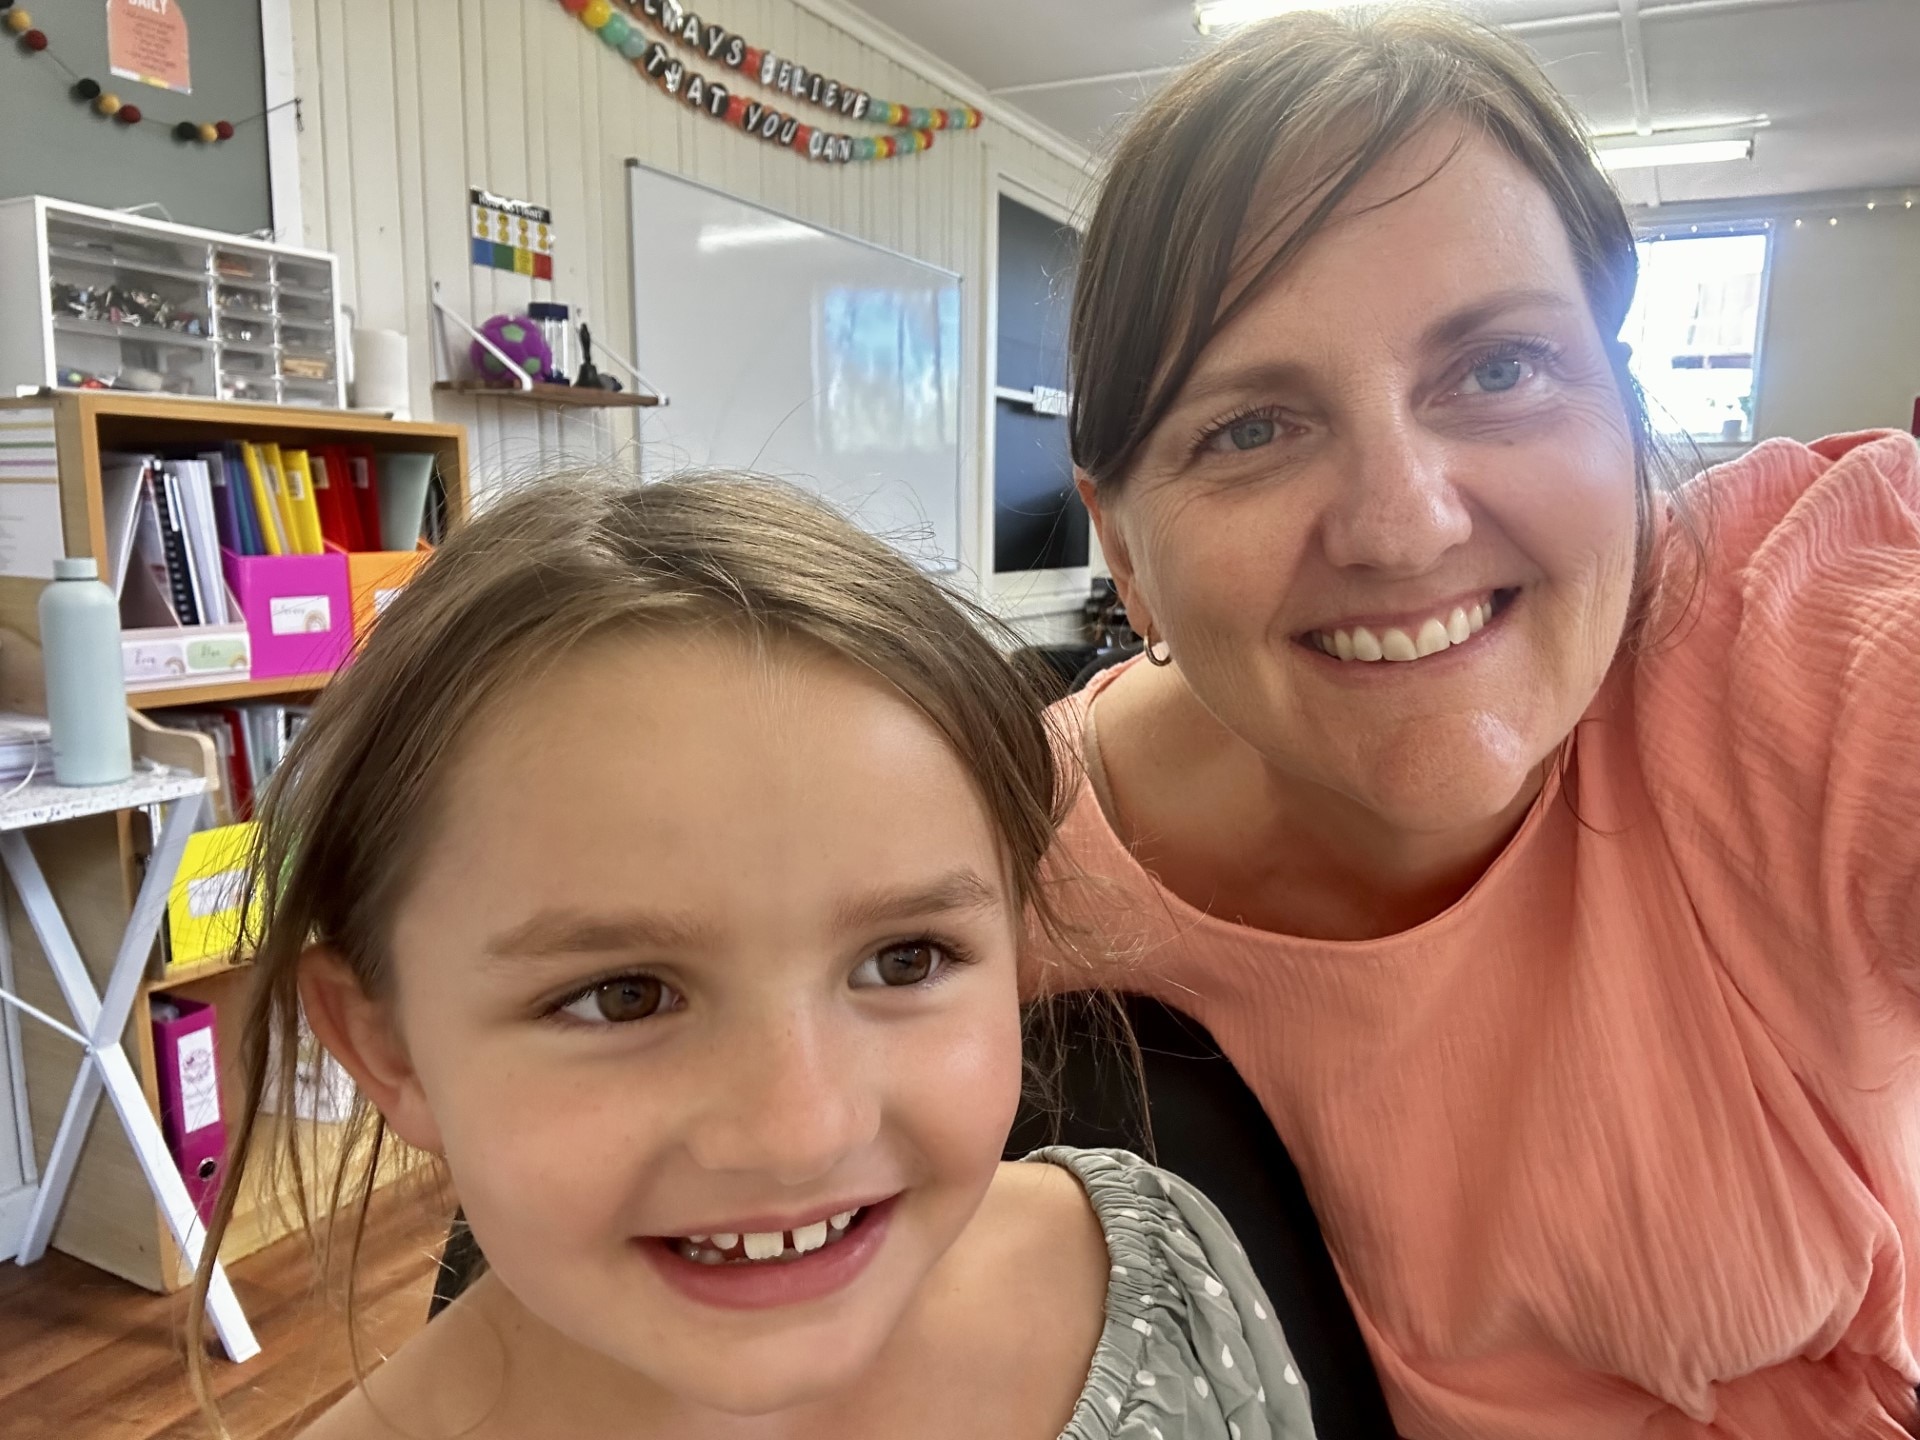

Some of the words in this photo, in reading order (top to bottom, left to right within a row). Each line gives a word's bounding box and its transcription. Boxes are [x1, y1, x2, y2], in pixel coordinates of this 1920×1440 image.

[629, 0, 743, 66] LWAYS
[761, 54, 869, 119] BELIEVE
[647, 44, 727, 113] THAT
[746, 104, 799, 144] YOU
[808, 130, 853, 161] CAN
